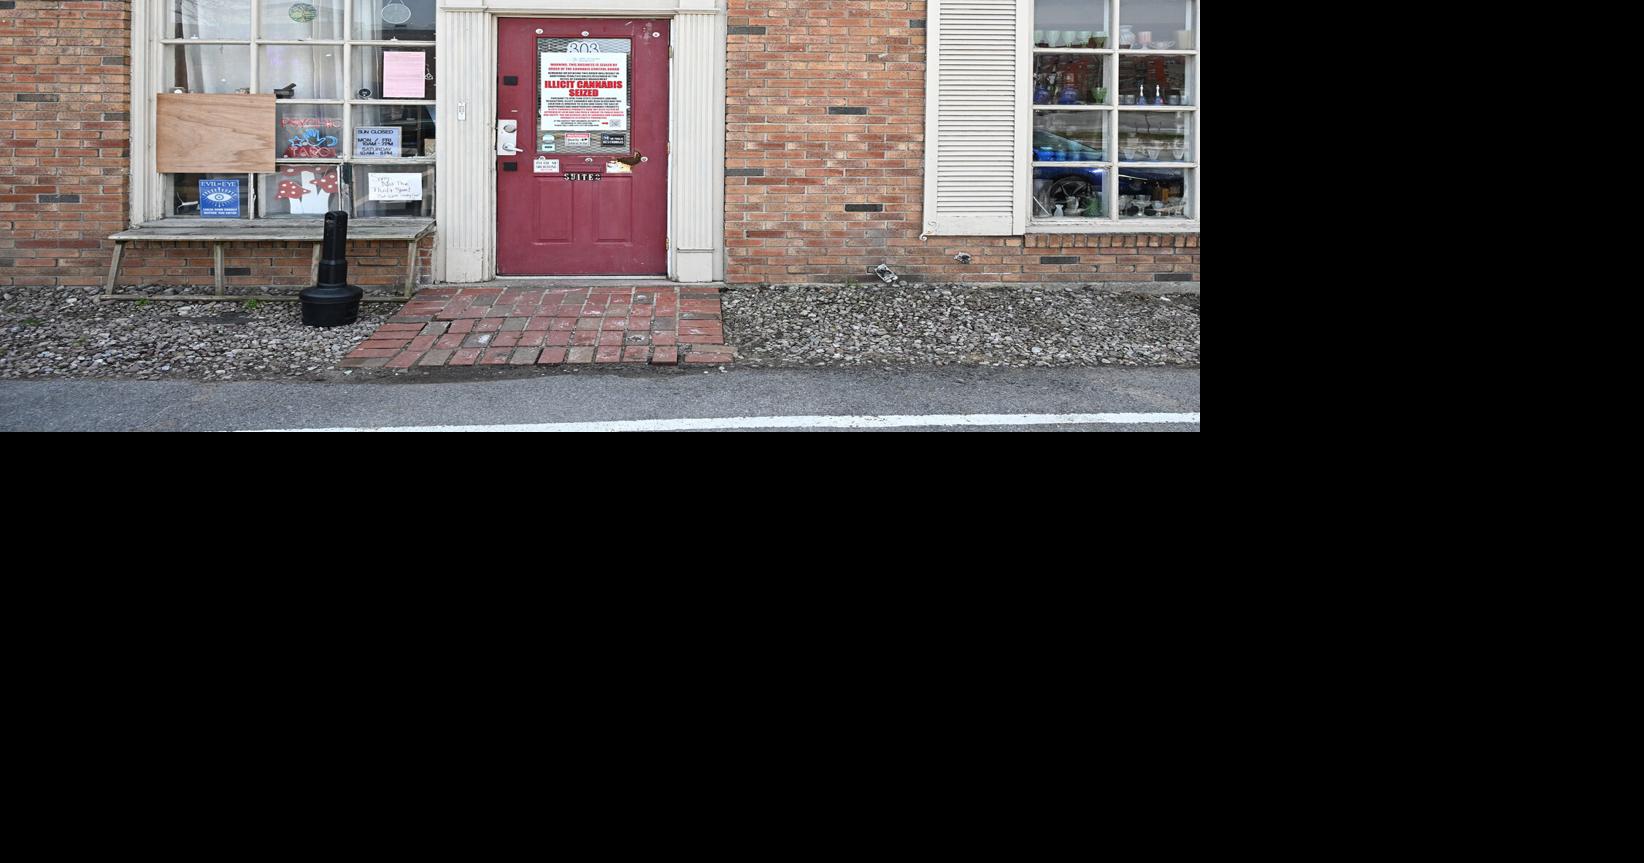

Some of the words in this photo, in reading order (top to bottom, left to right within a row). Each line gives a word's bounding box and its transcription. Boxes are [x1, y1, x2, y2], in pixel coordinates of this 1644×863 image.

[544, 80, 575, 88] ILLICIT
[577, 80, 623, 88] CANNABIS
[569, 89, 599, 97] SEIZED
